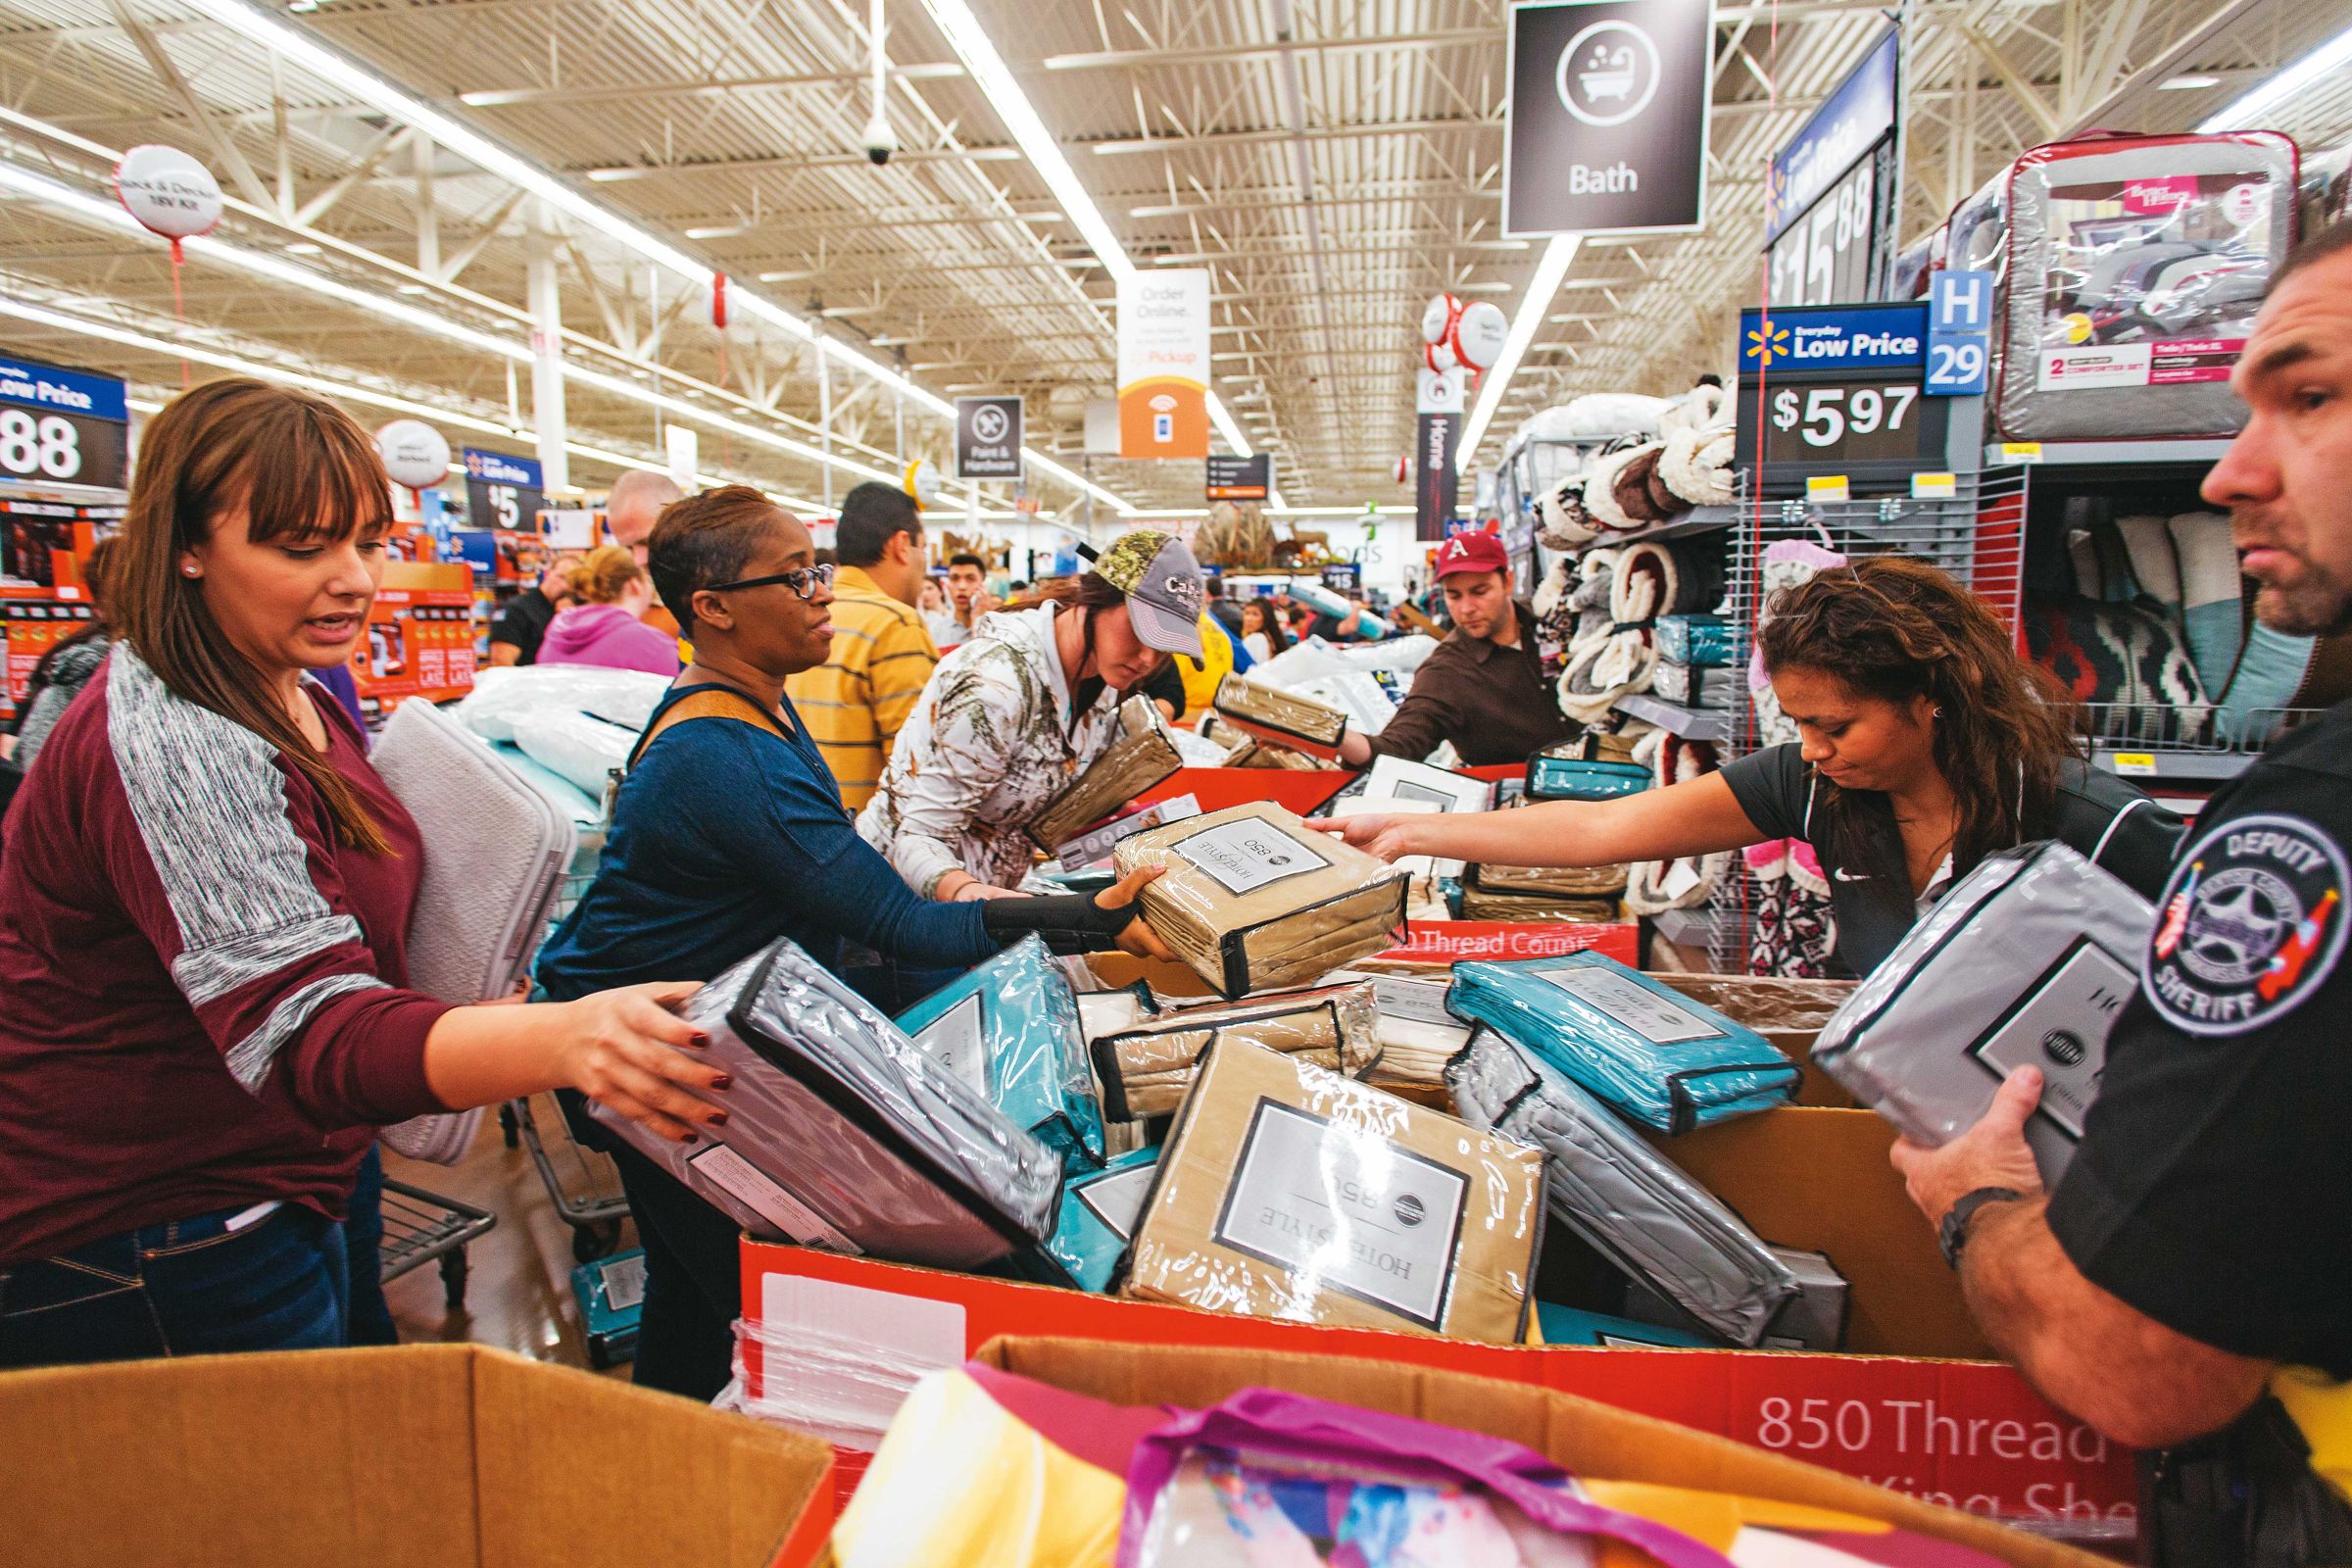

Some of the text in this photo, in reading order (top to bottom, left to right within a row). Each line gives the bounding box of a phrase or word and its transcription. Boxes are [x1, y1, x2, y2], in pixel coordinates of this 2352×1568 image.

[1569, 161, 1638, 194] Bath
[1141, 285, 1185, 301] Order
[1941, 277, 1981, 324] H
[1793, 332, 1919, 359] Low Price
[1794, 325, 1842, 338] Everyday
[1929, 344, 1984, 385] 29
[2049, 358, 2065, 375] 2
[36, 380, 93, 410] Price
[0, 409, 82, 479] 88
[1428, 418, 1449, 470] Home
[1447, 540, 1468, 560] A
[1244, 839, 1272, 858] 850
[2227, 831, 2328, 874] DEPUTY
[1421, 930, 1504, 955] Thread
[2155, 965, 2255, 1020] SHERIFF
[1260, 1206, 1413, 1280] HOTE STYLE
[1757, 1396, 2107, 1463] 850 Thread
